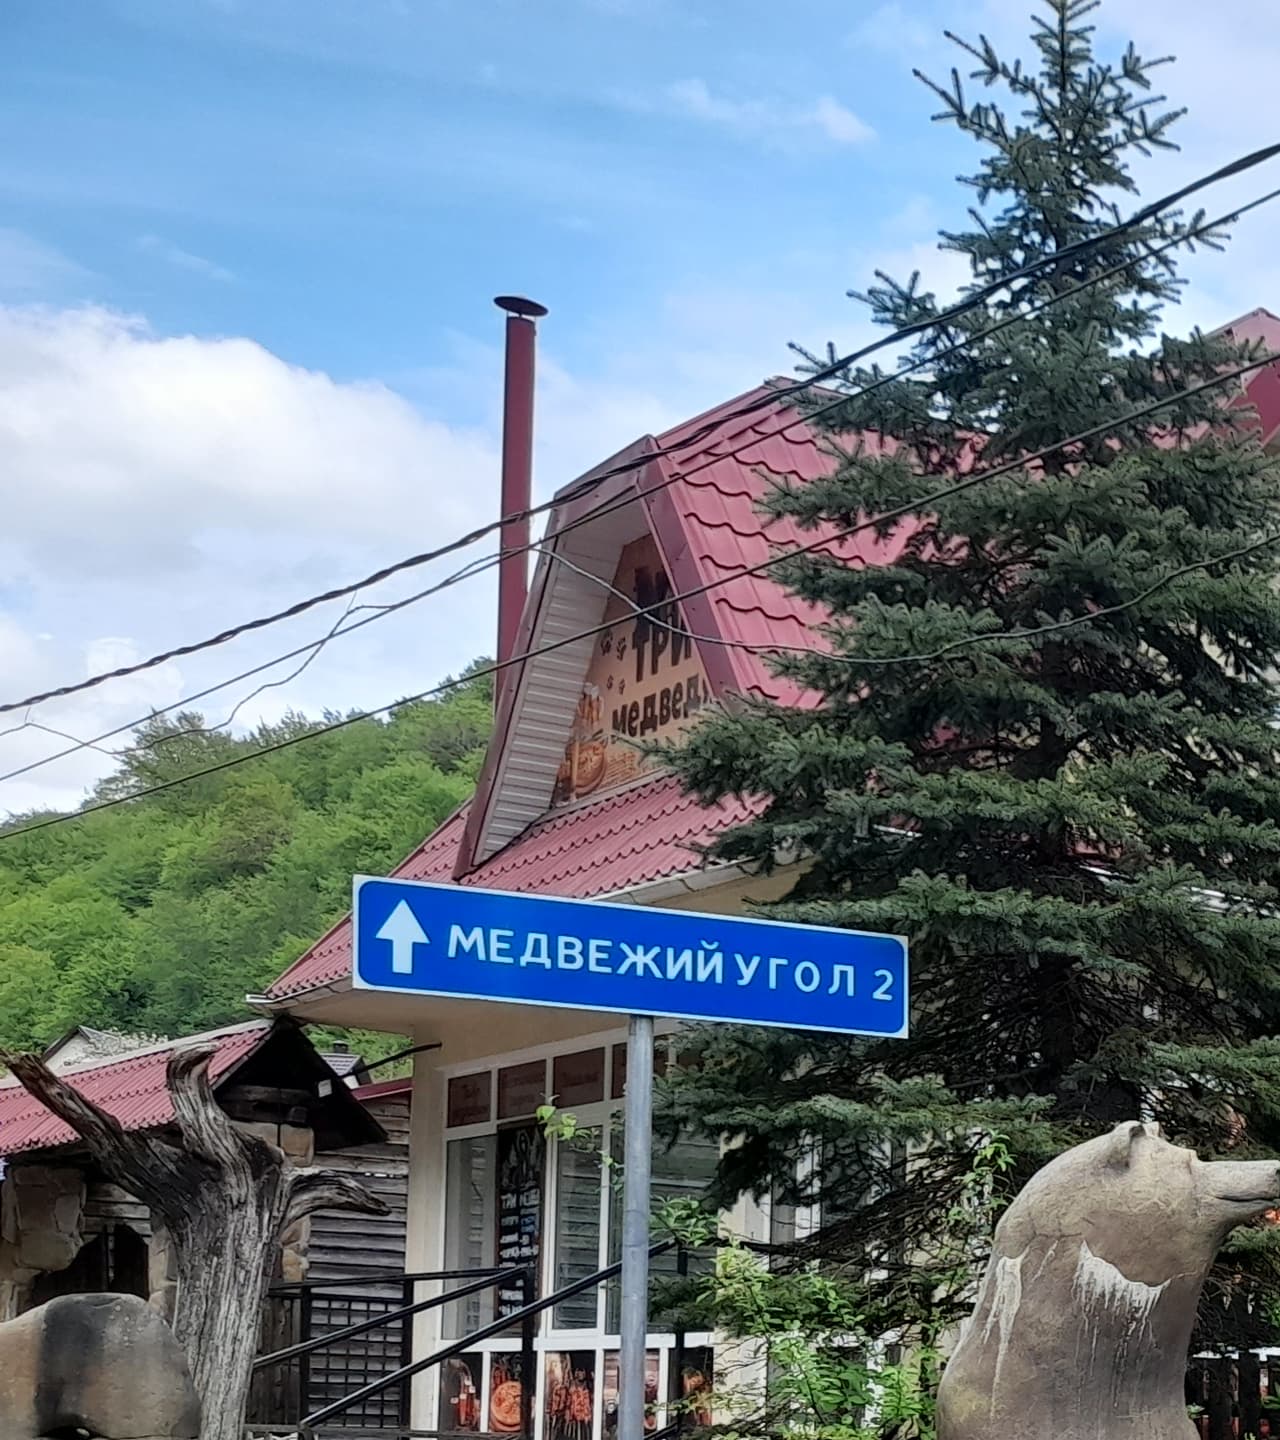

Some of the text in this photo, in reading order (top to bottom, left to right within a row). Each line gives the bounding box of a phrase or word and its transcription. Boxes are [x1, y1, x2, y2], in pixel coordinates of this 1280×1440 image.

[446, 923, 894, 1001] МЕДВЕЖИЙ УГОЛ 2
